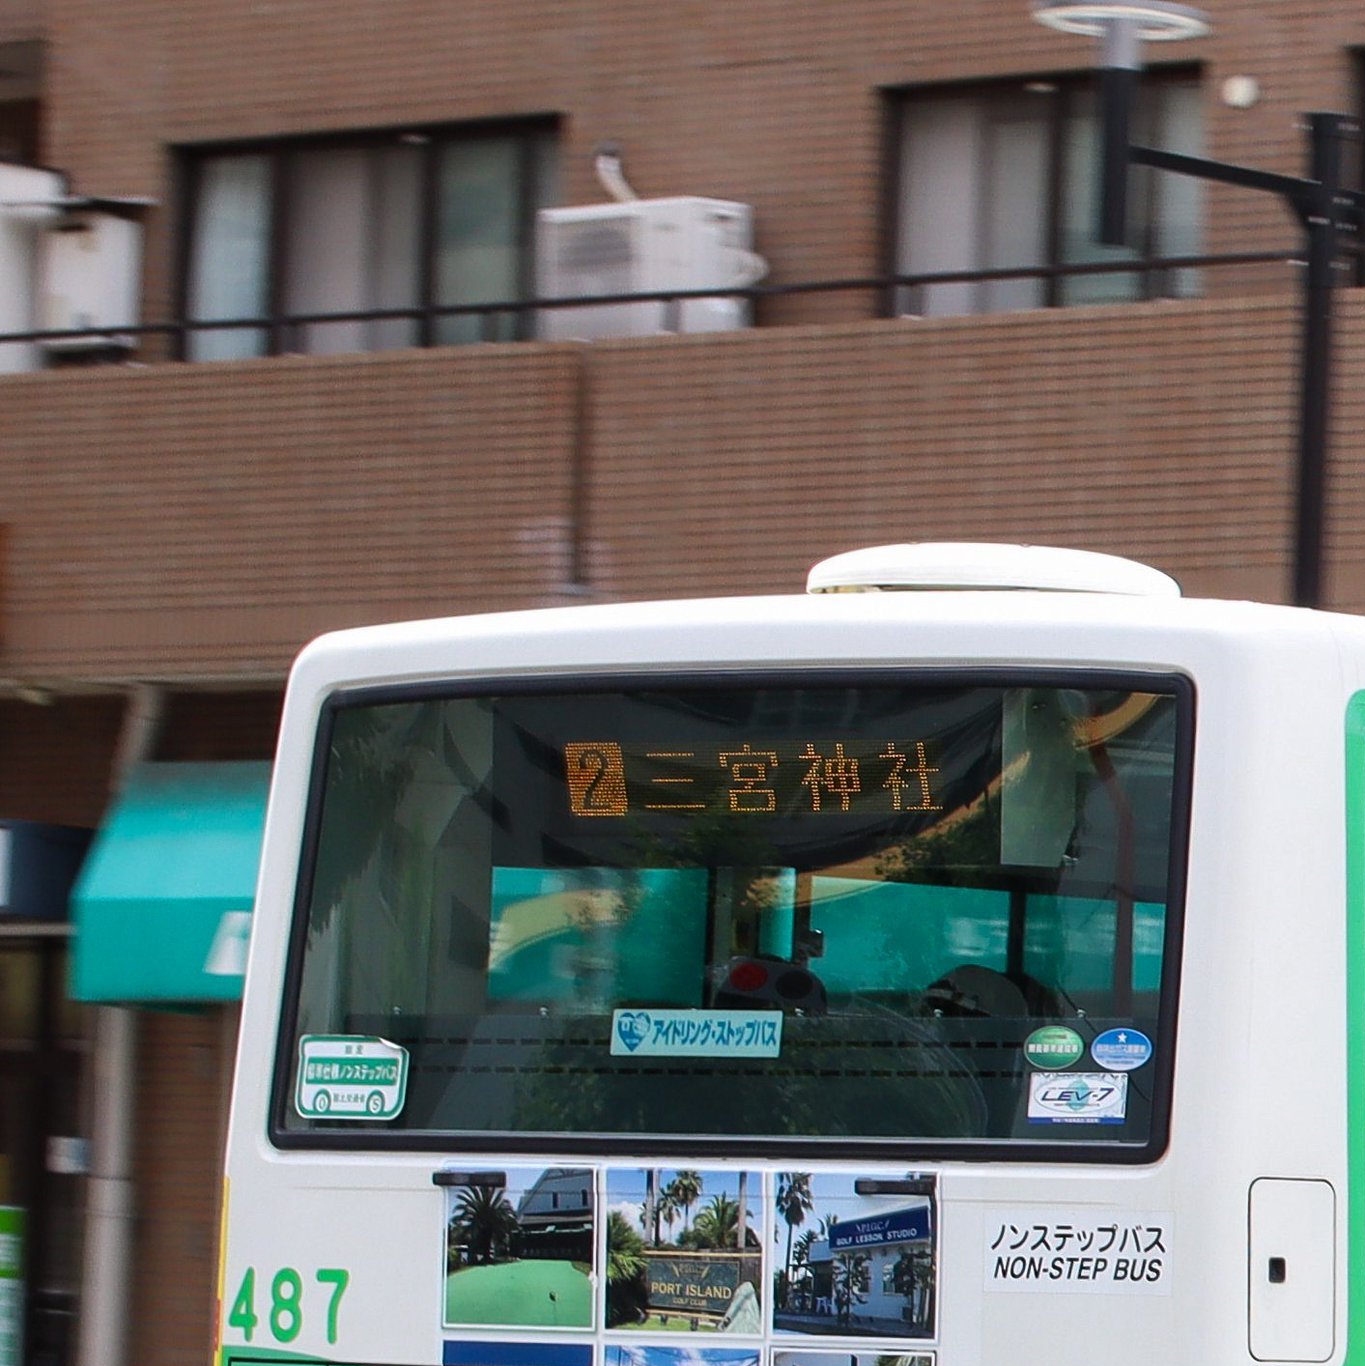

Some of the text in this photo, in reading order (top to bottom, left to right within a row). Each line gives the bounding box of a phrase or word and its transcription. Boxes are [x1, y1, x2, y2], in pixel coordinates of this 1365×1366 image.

[575, 742, 944, 813] 2 三宮神社
[1041, 1087, 1115, 1102] LEV-7
[887, 1228, 918, 1240] STUDIO
[990, 1223, 1166, 1253] ノンステップバス
[993, 1256, 1163, 1282] NON-STEP BUS
[651, 1281, 732, 1299] PORT ISLAND
[228, 1266, 350, 1345] 487
